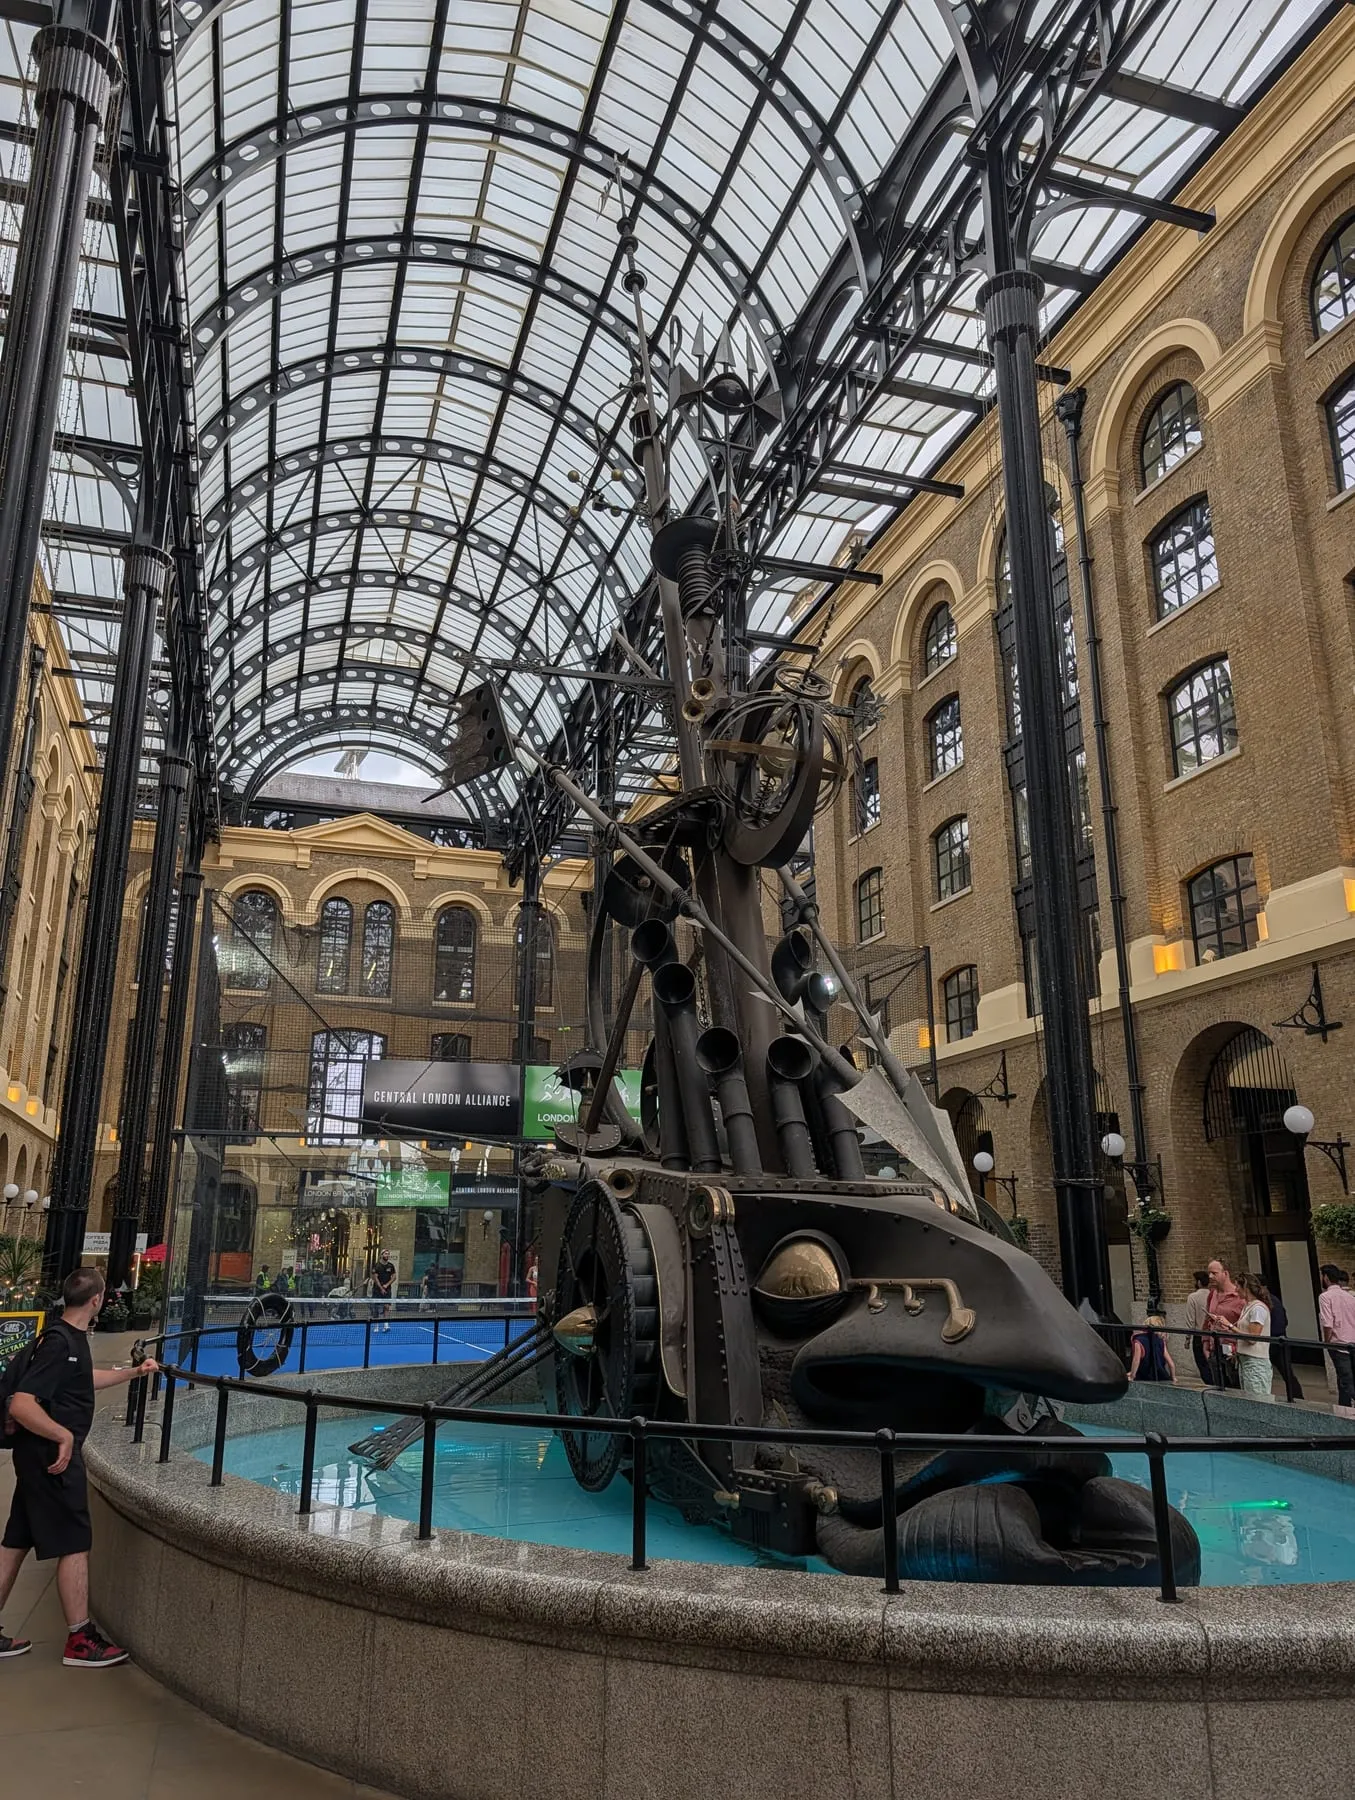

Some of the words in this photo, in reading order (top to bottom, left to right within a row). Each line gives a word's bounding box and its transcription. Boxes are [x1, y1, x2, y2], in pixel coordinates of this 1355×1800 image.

[373, 1090, 417, 1104] CENTRAL
[422, 1092, 461, 1105] LONDON
[465, 1094, 511, 1107] ALLIANCE
[537, 1113, 577, 1123] LONDON
